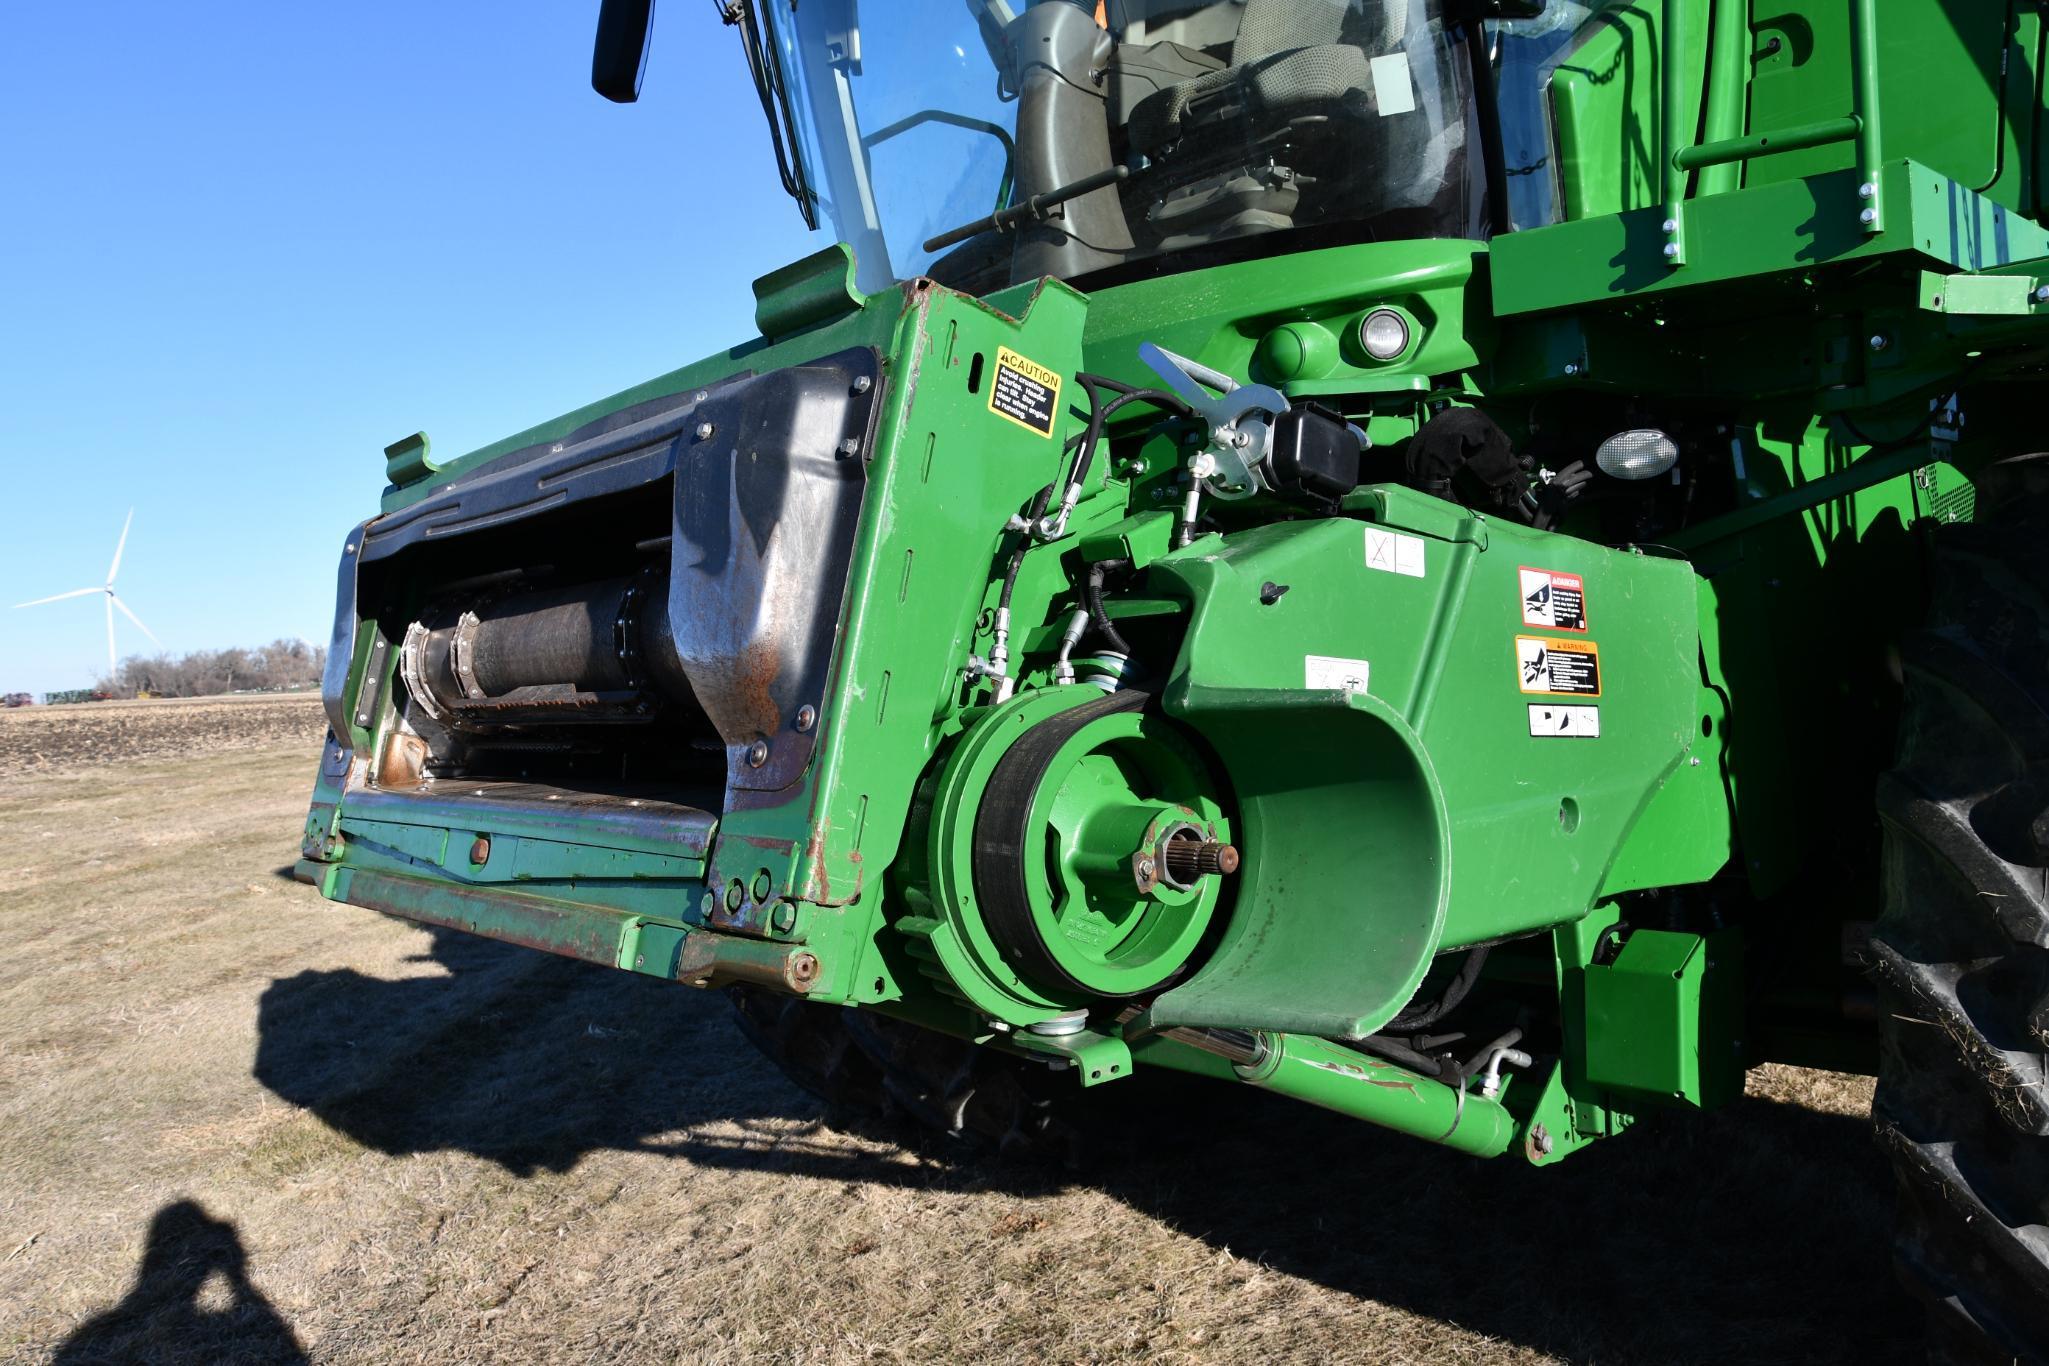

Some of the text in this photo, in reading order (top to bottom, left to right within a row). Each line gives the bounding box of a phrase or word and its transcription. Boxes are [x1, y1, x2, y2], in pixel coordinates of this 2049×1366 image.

[1001, 367, 1045, 395] Avoid crushing
[1010, 356, 1058, 387] CAUTION
[998, 384, 1009, 393] can
[1022, 394, 1036, 406] Stay
[1025, 388, 1047, 403] Header
[996, 392, 1049, 421] clear when engine
[1001, 402, 1026, 419] running.
[1556, 578, 1580, 588] DANGER
[1563, 643, 1588, 651] WARNING
